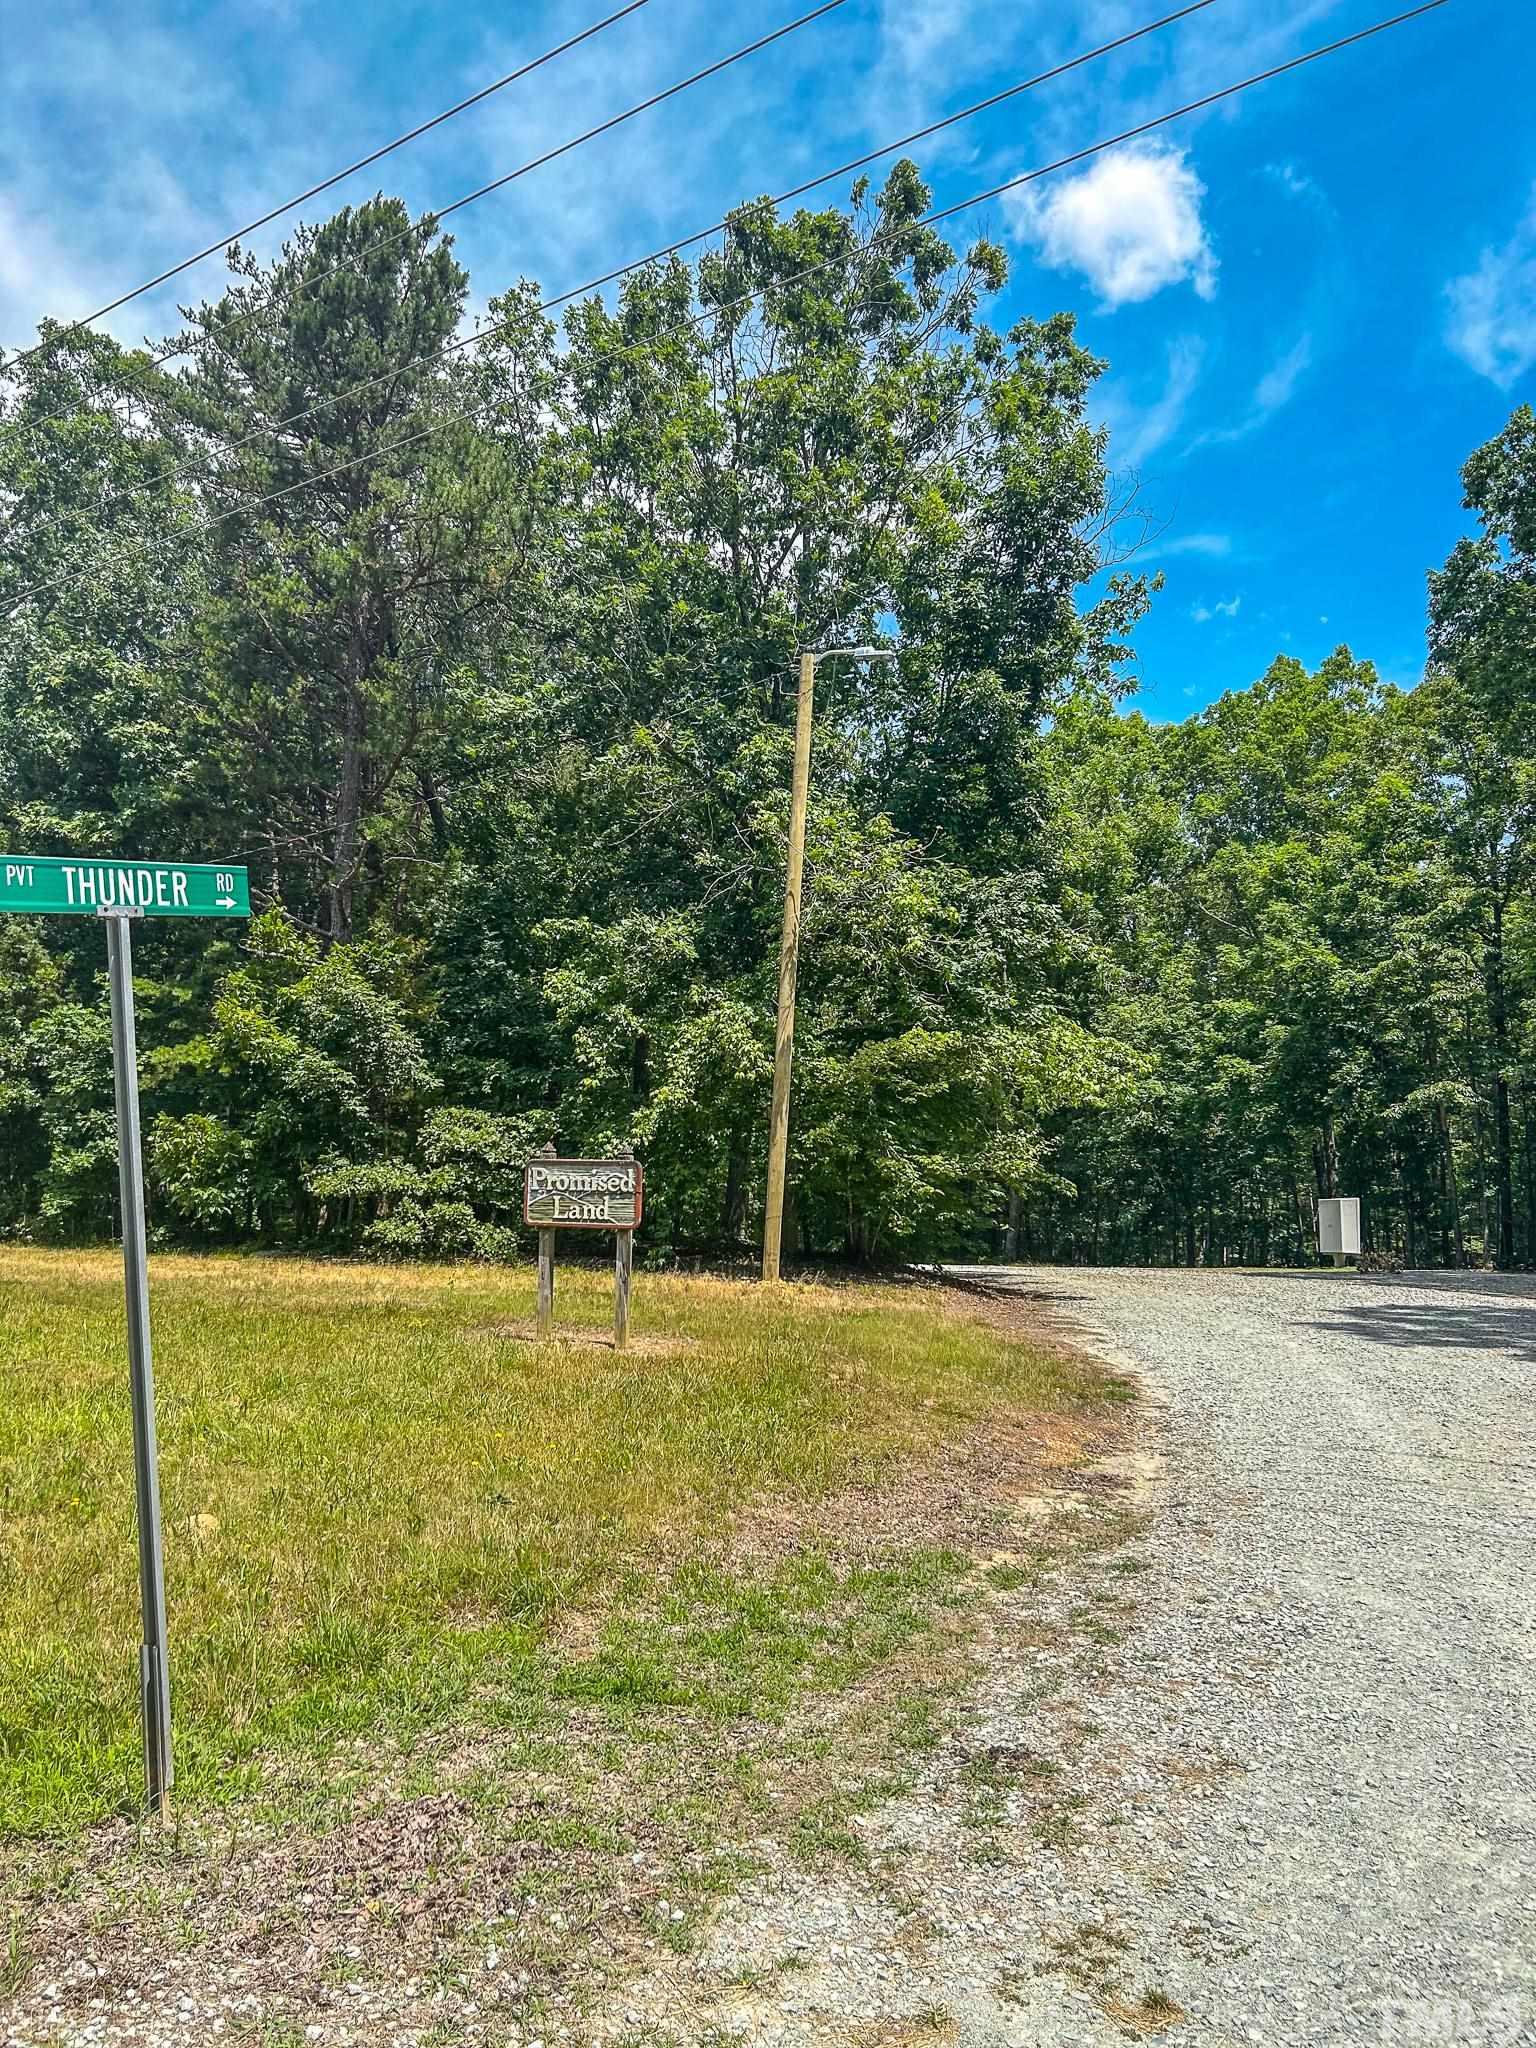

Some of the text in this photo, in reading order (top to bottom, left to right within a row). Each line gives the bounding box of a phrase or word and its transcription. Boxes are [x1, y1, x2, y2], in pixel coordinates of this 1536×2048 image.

[6, 864, 234, 907] PVT THUNDER RD
[531, 1167, 635, 1192] Promised
[552, 1195, 609, 1220] Land
